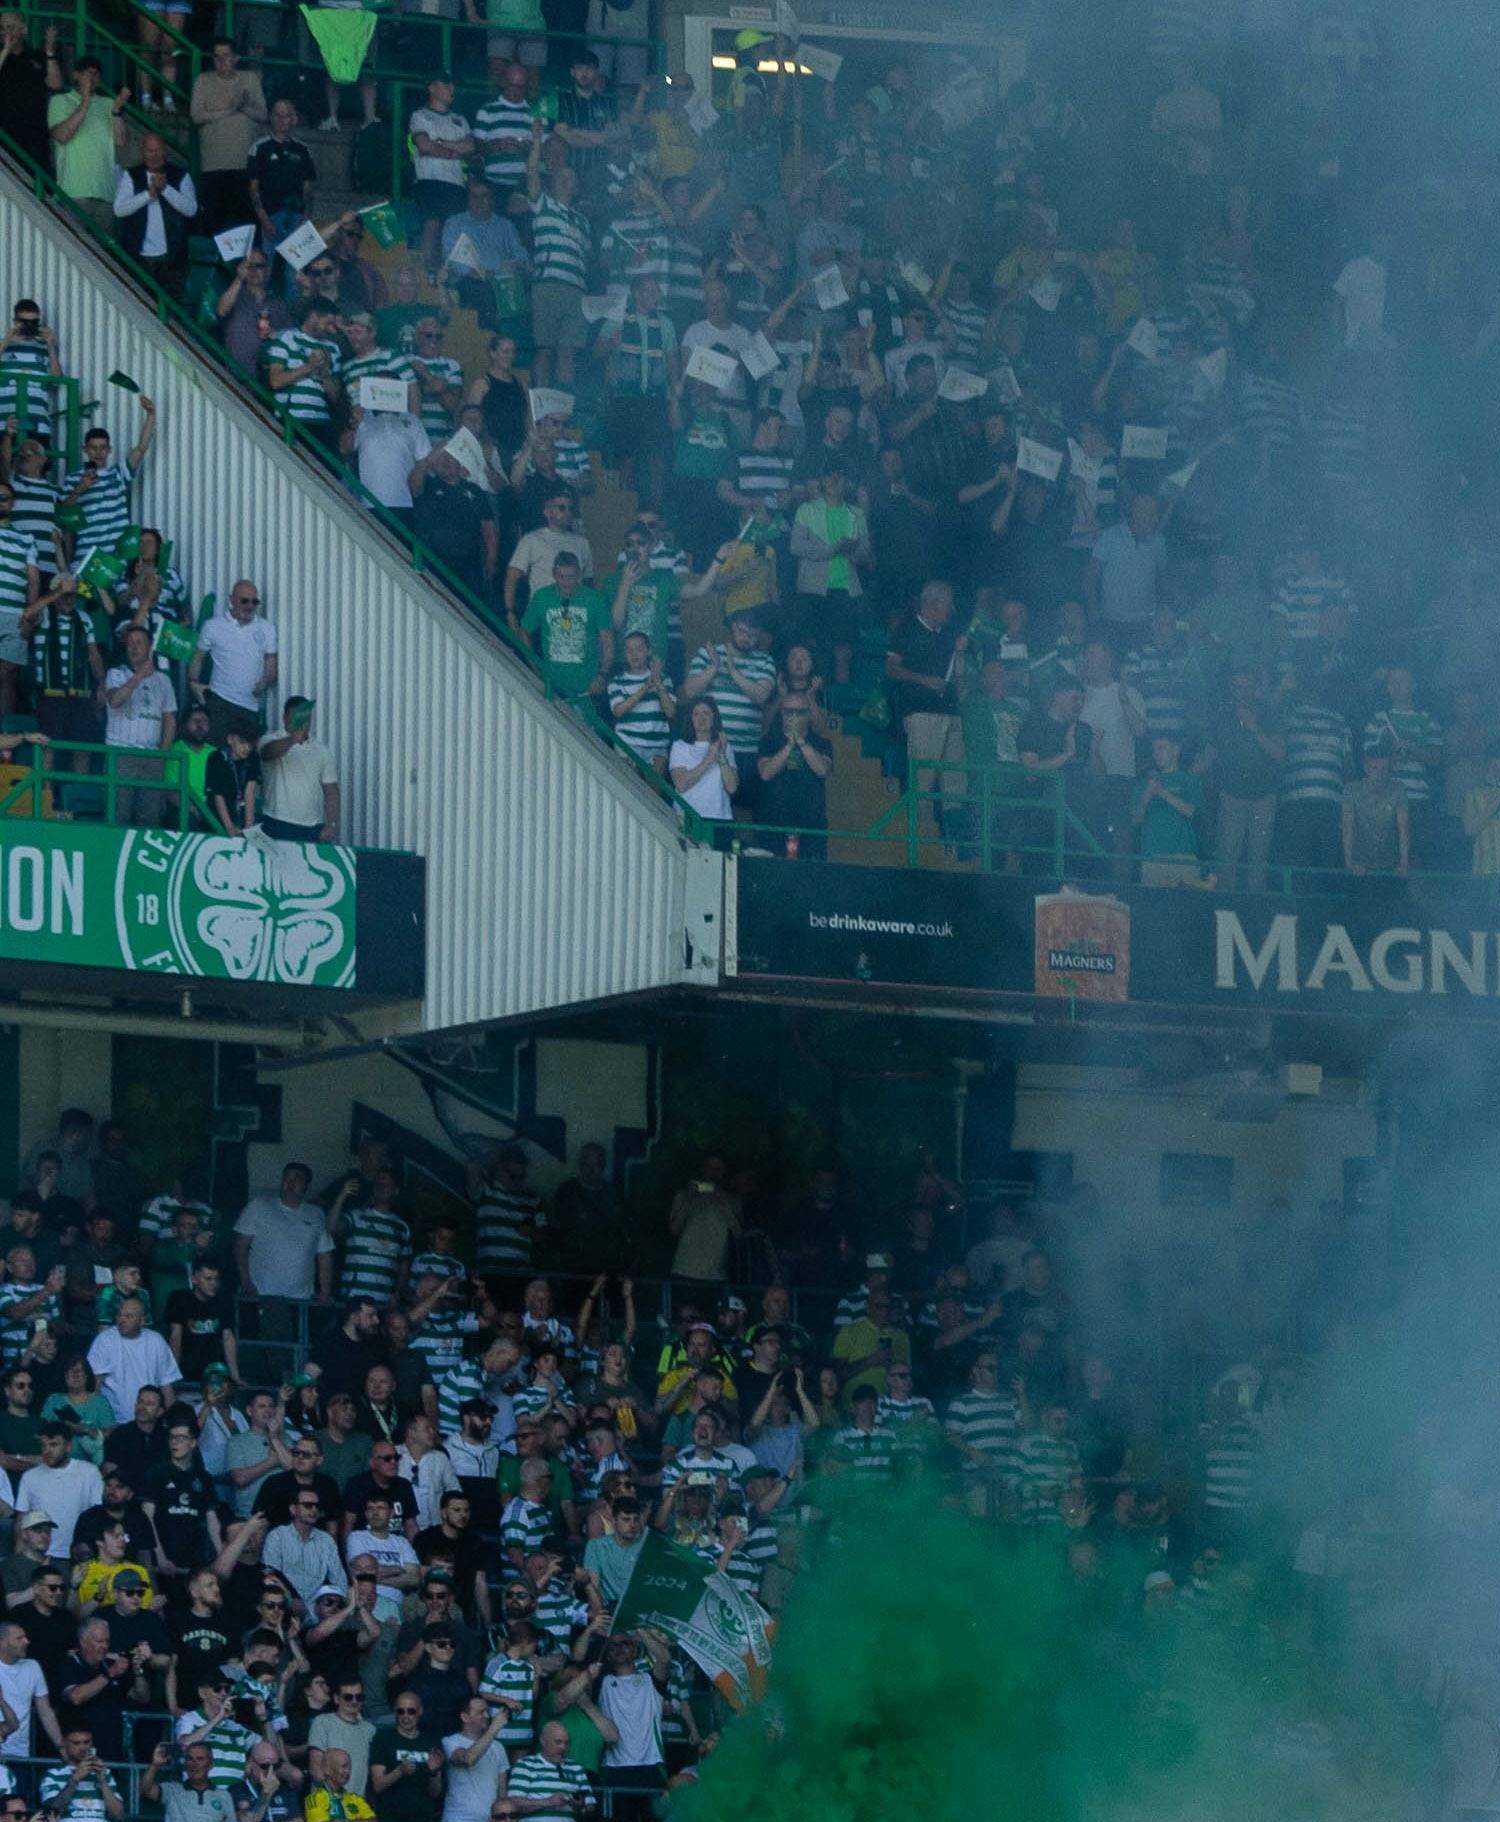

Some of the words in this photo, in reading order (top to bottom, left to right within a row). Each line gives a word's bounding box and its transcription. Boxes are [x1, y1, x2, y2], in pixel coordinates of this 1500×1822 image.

[0, 845, 84, 936] ON
[136, 893, 159, 926] 18
[809, 911, 954, 939] bedrinkaware.co.uk
[1050, 951, 1114, 972] MAGNERS
